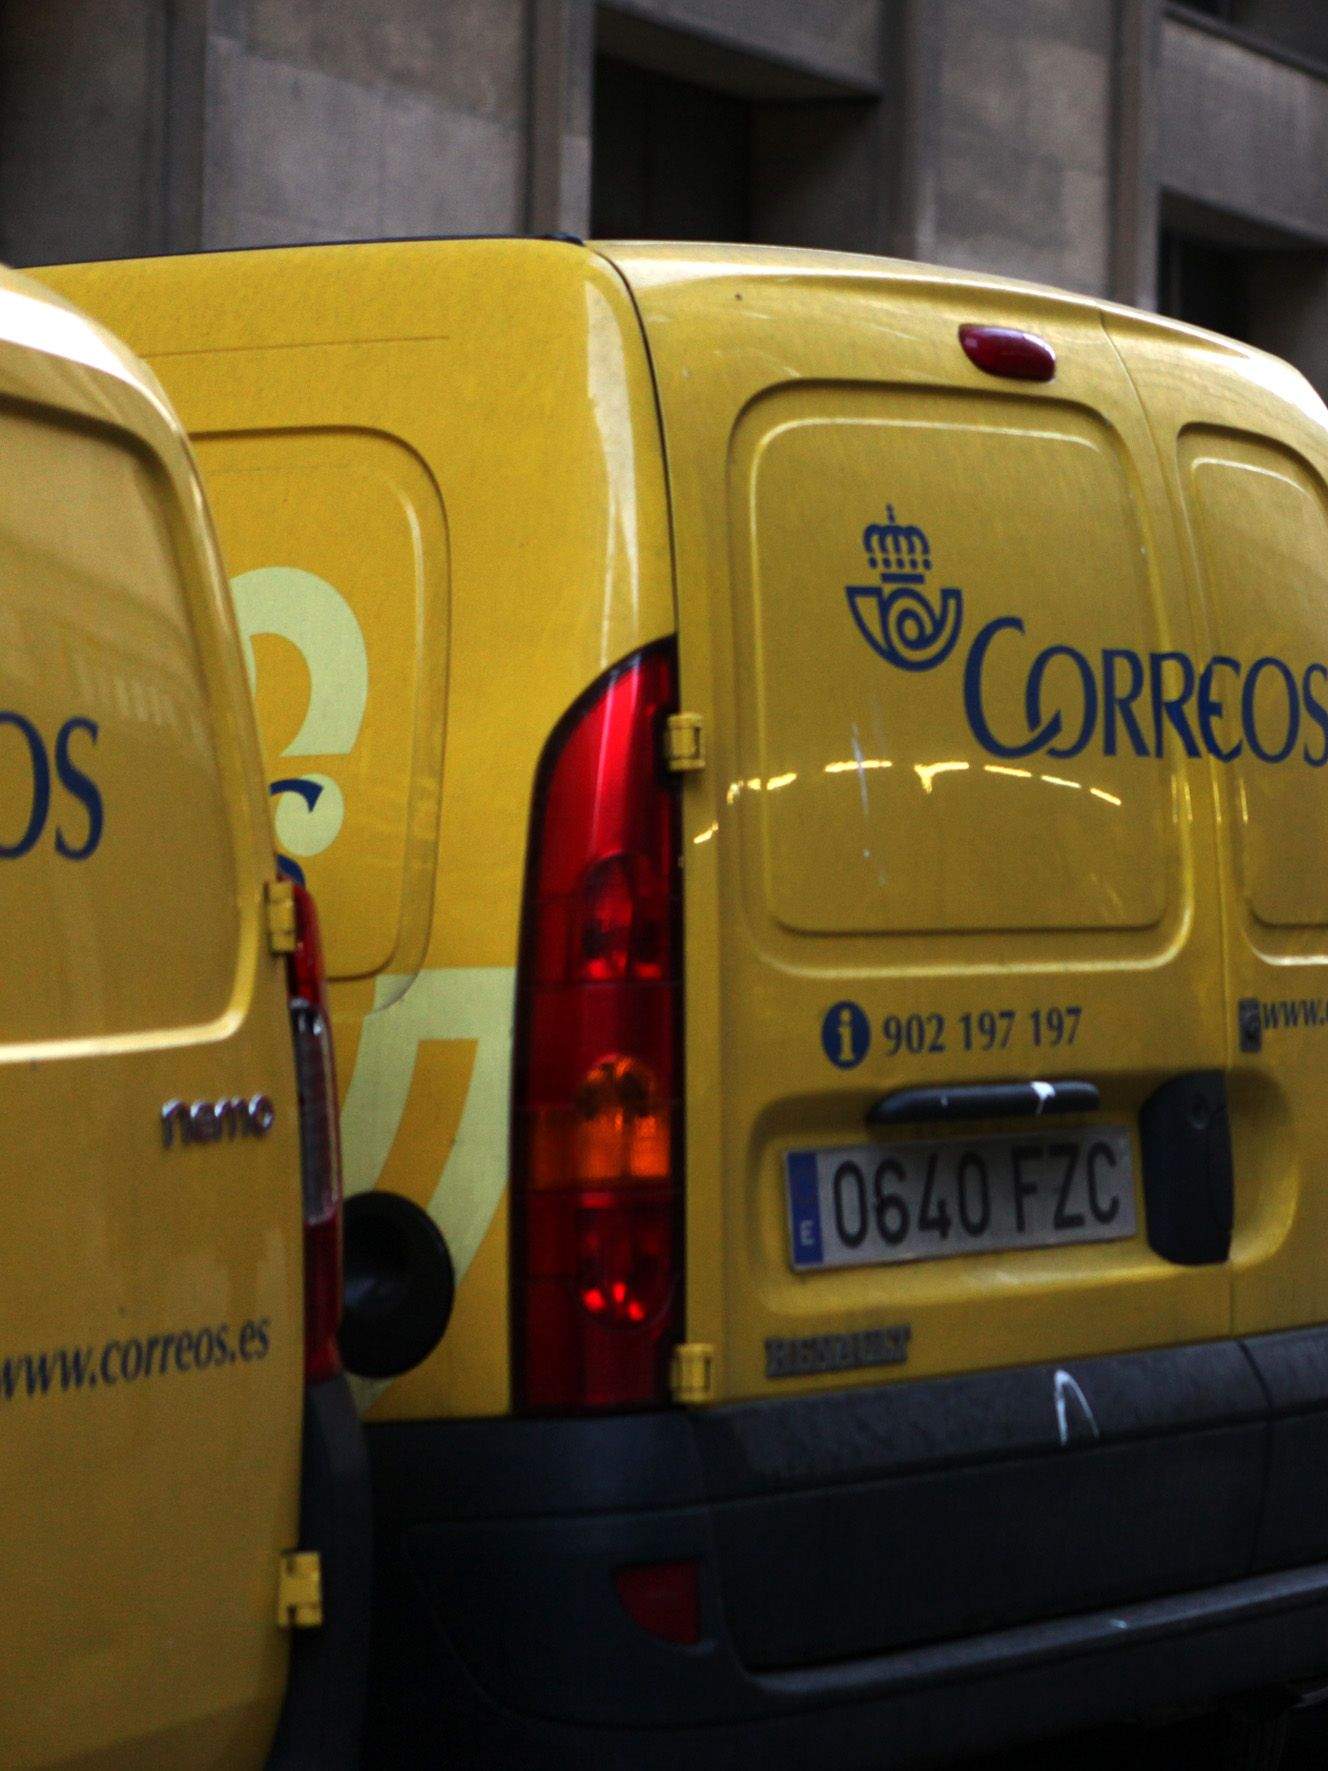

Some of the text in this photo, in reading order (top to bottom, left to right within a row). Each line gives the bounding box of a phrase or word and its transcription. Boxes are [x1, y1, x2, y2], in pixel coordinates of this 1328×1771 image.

[882, 1013, 946, 1057] 902
[959, 1009, 1016, 1051] 197
[1030, 1005, 1083, 1047] 197
[832, 1152, 992, 1249] 0640
[1011, 1141, 1121, 1234] FZC
